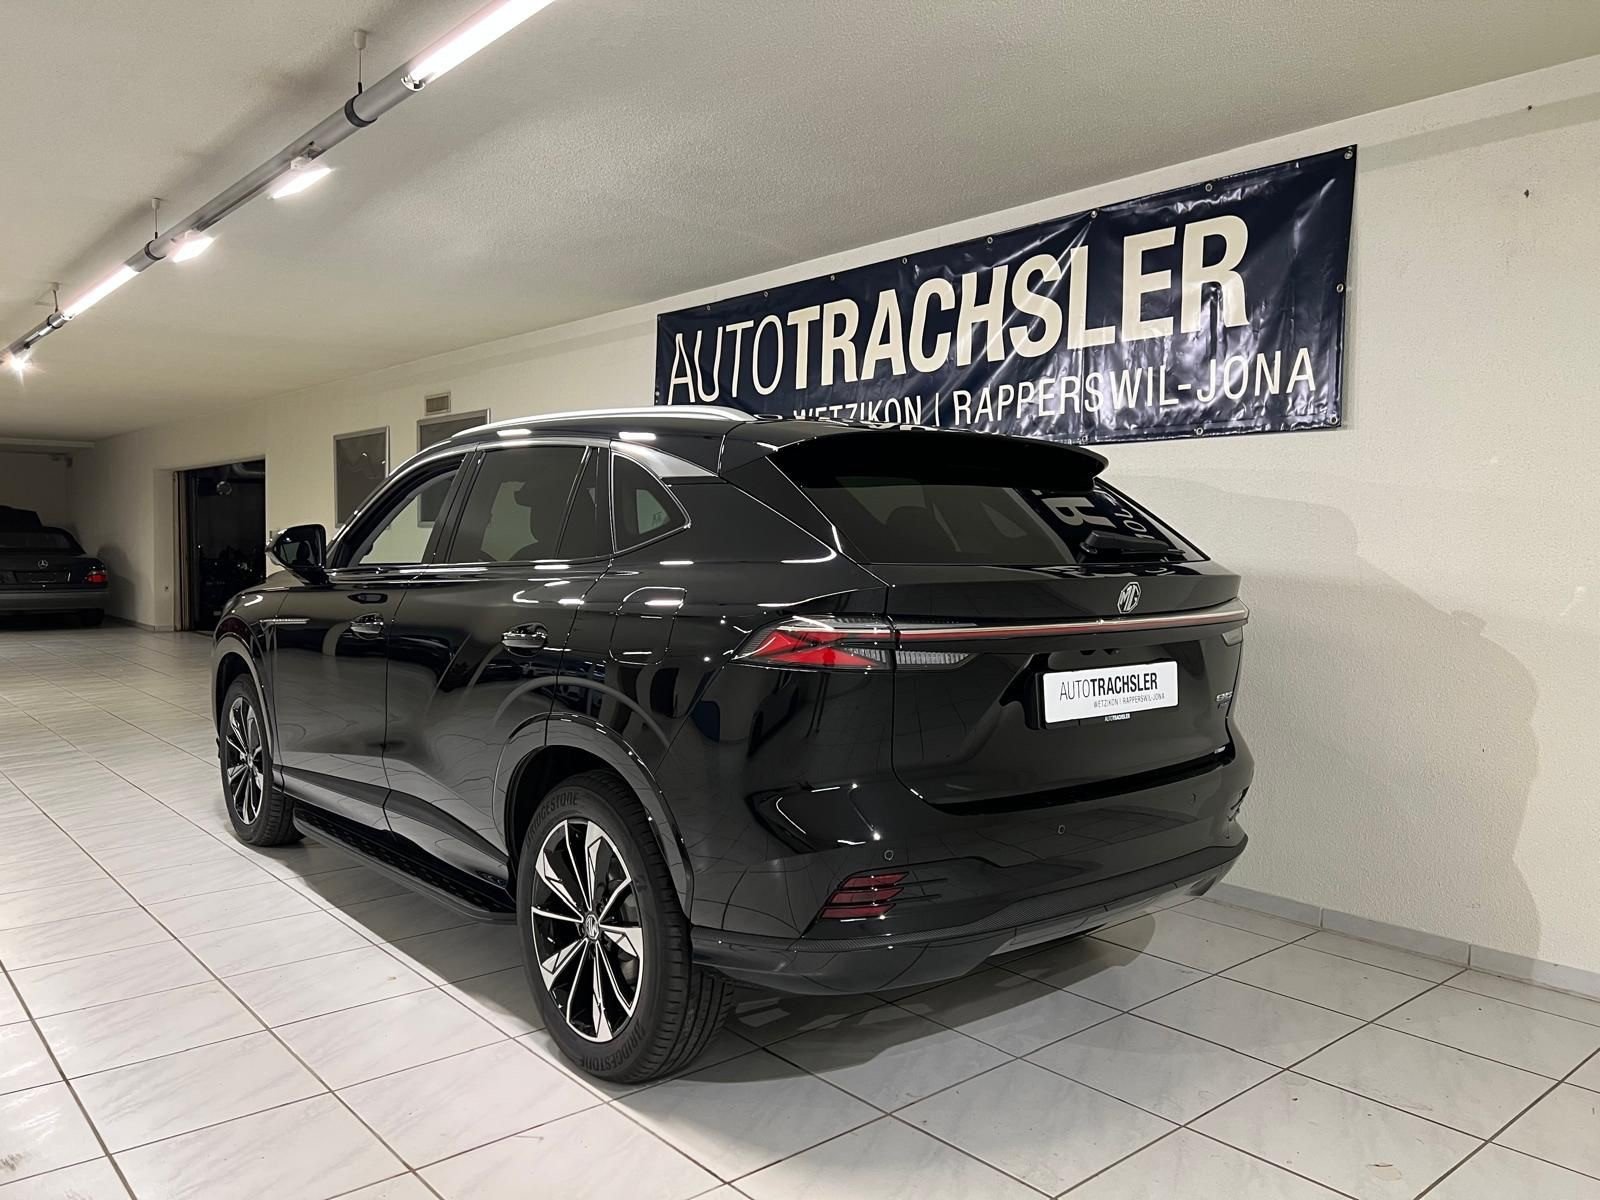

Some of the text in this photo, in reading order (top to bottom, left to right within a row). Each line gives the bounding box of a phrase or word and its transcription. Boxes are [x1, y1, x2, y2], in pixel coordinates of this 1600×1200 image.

[667, 215, 1250, 406] AUTOTRACHSLER
[954, 347, 1316, 426] RAPPERSWIL-JONA
[1118, 583, 1140, 612] MG
[1060, 672, 1158, 701] AUTOTRACHSLER
